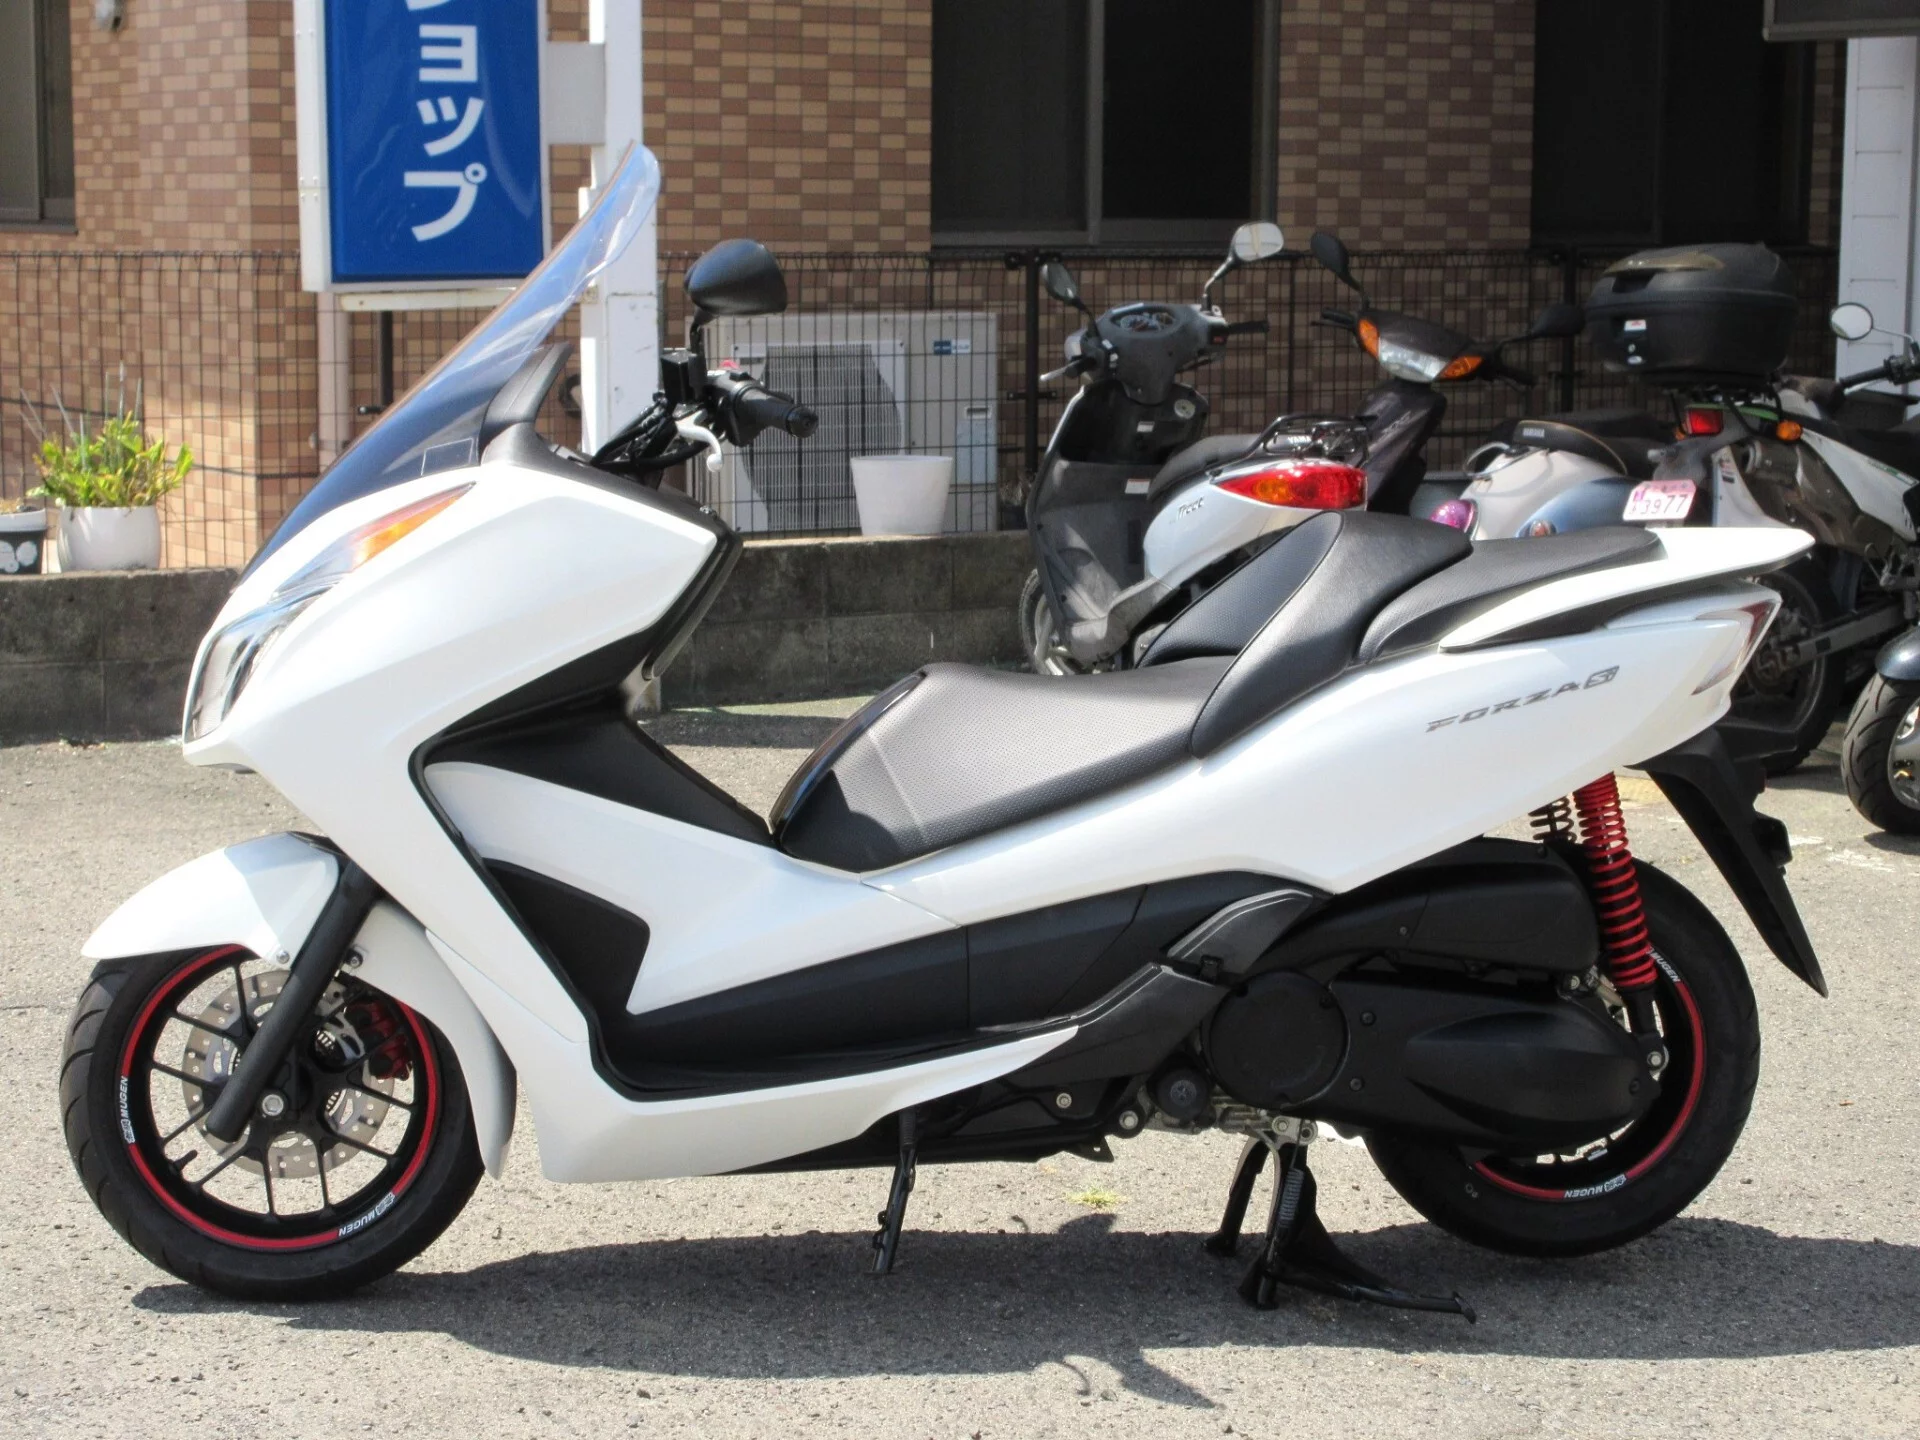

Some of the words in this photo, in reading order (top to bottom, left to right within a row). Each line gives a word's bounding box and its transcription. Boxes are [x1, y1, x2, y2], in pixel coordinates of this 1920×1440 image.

[1426, 681, 1582, 733] FORZA
[1650, 951, 1681, 983] MUGEN
[119, 1076, 129, 1119] MUGEN
[1563, 1185, 1604, 1199] MUGEN
[338, 1209, 376, 1237] MUGEN
